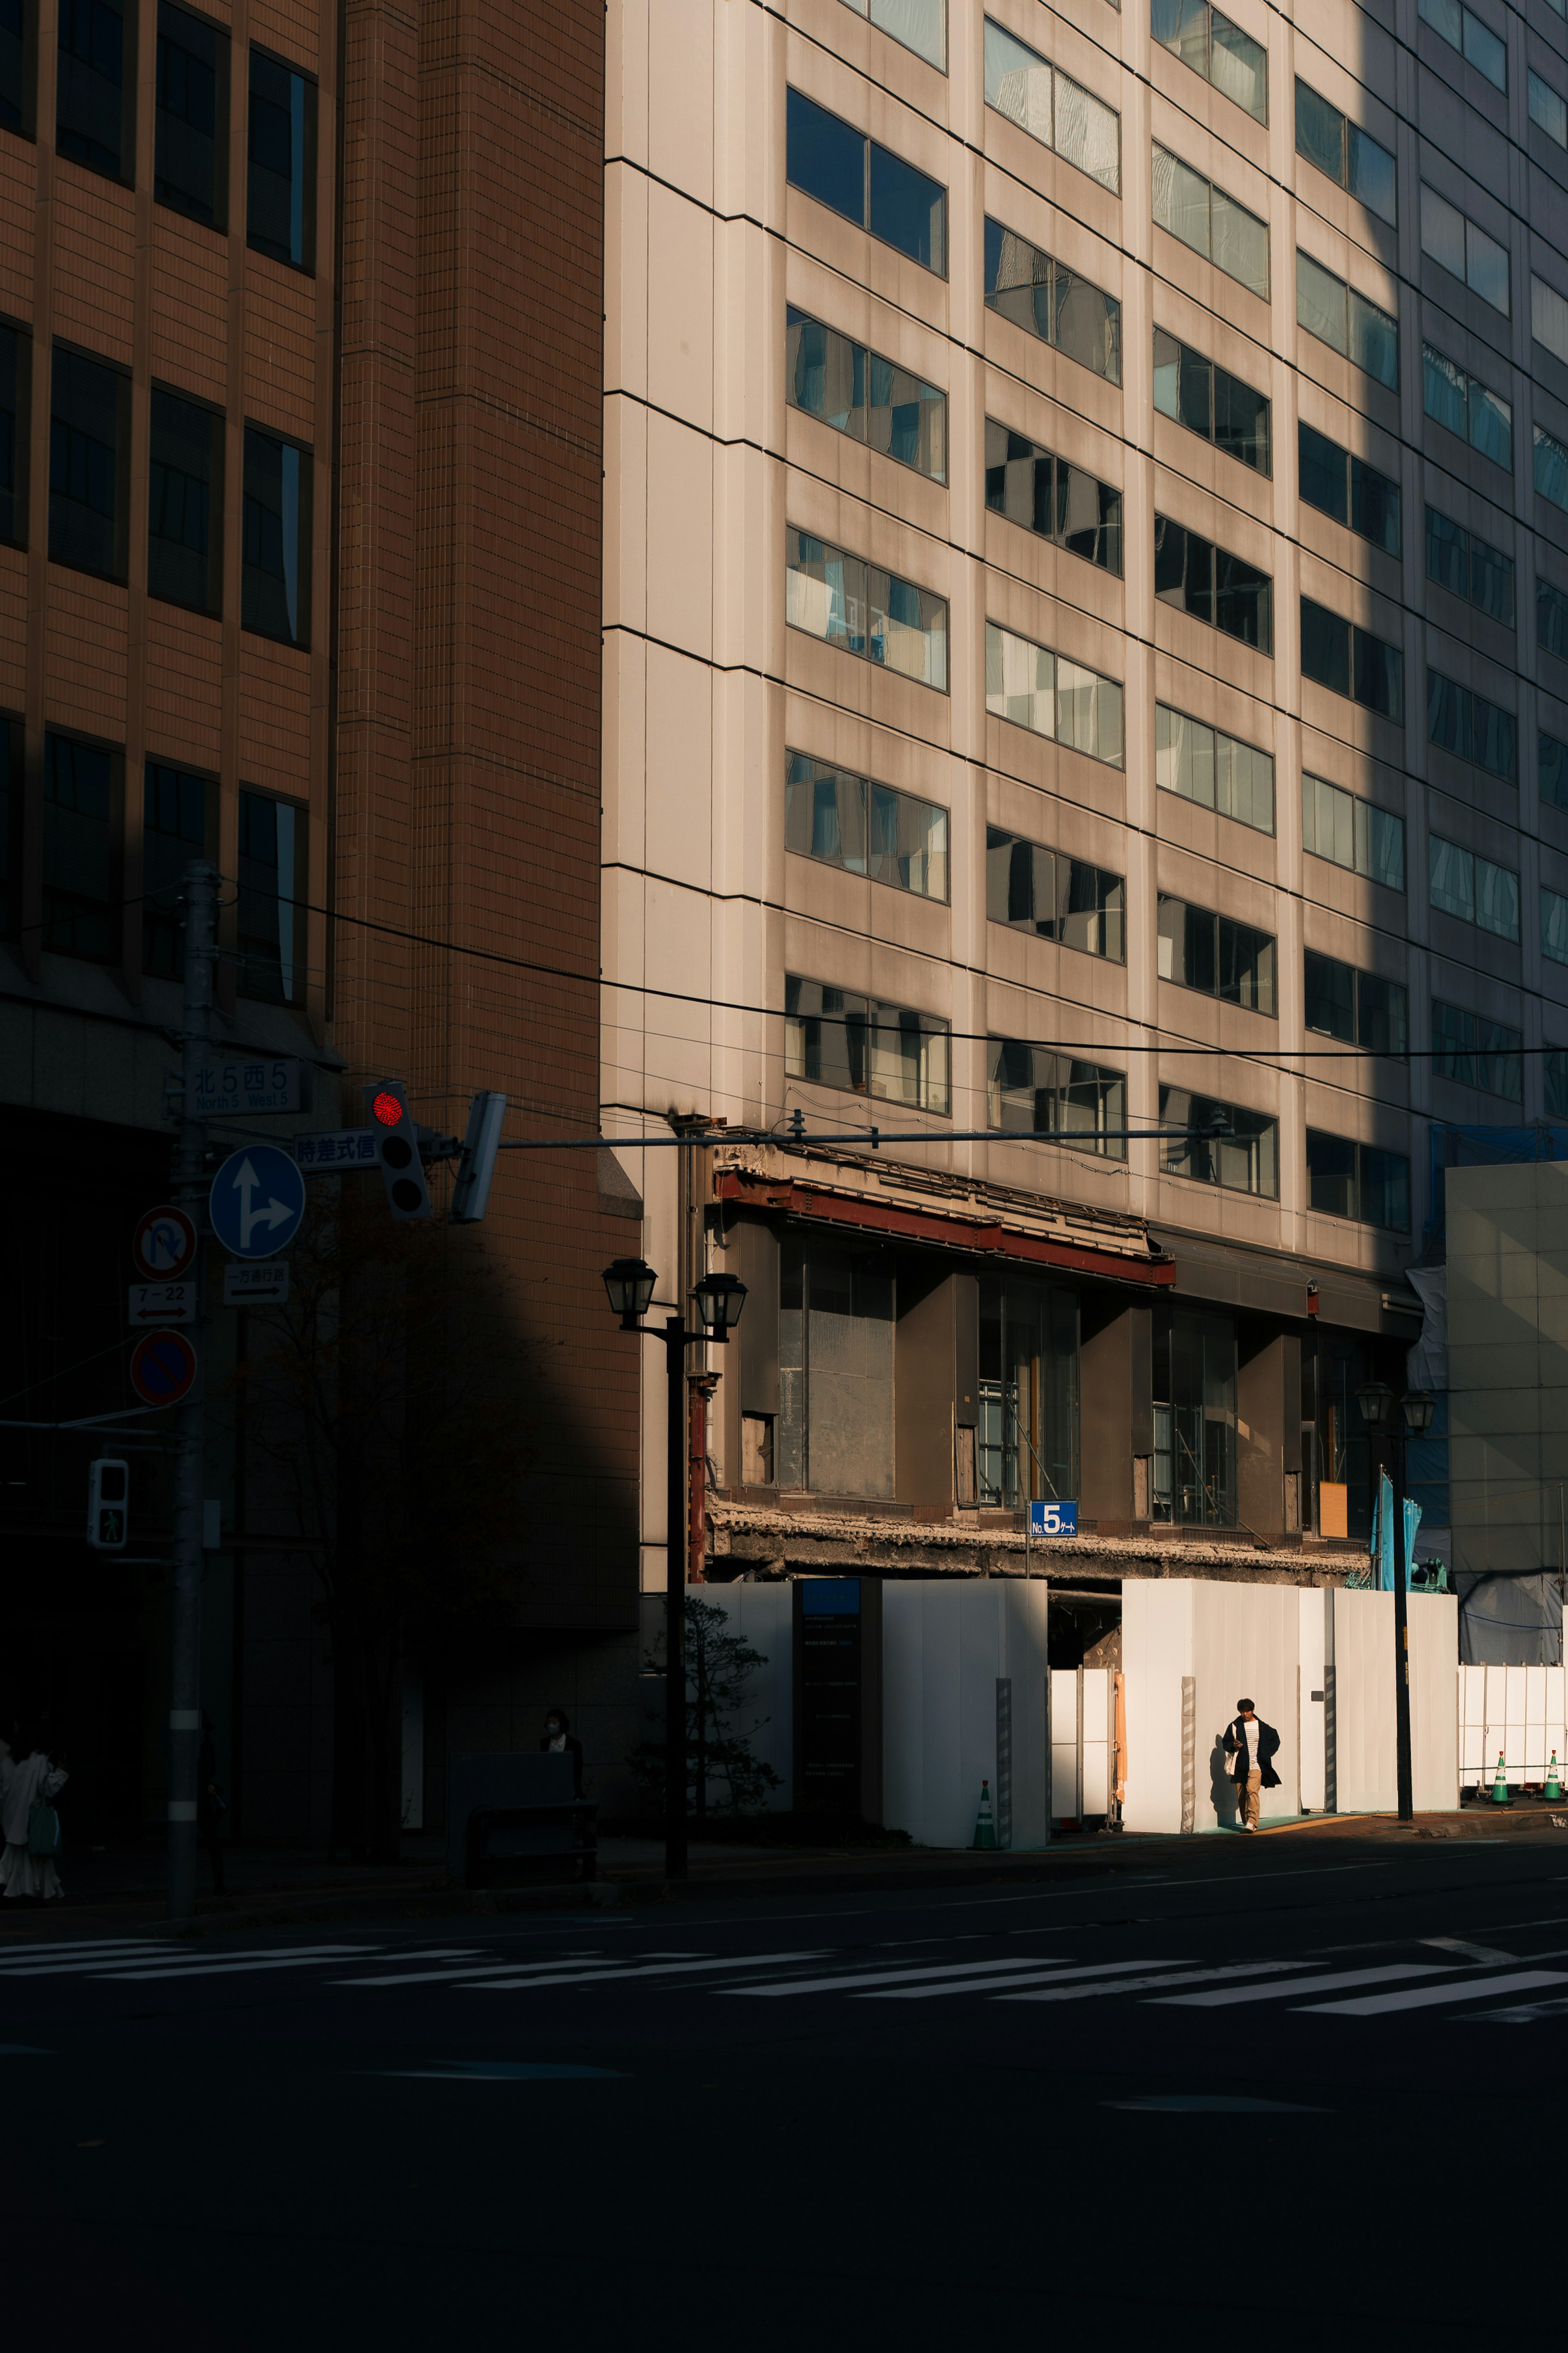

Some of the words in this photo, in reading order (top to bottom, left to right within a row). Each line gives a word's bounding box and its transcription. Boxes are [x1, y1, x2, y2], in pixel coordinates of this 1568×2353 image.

[195, 1062, 287, 1094] 北5西5
[197, 1095, 228, 1110] North
[232, 1095, 238, 1108] 5
[248, 1093, 276, 1107] West
[281, 1092, 287, 1105] 5
[229, 1268, 284, 1283] 一方通行路
